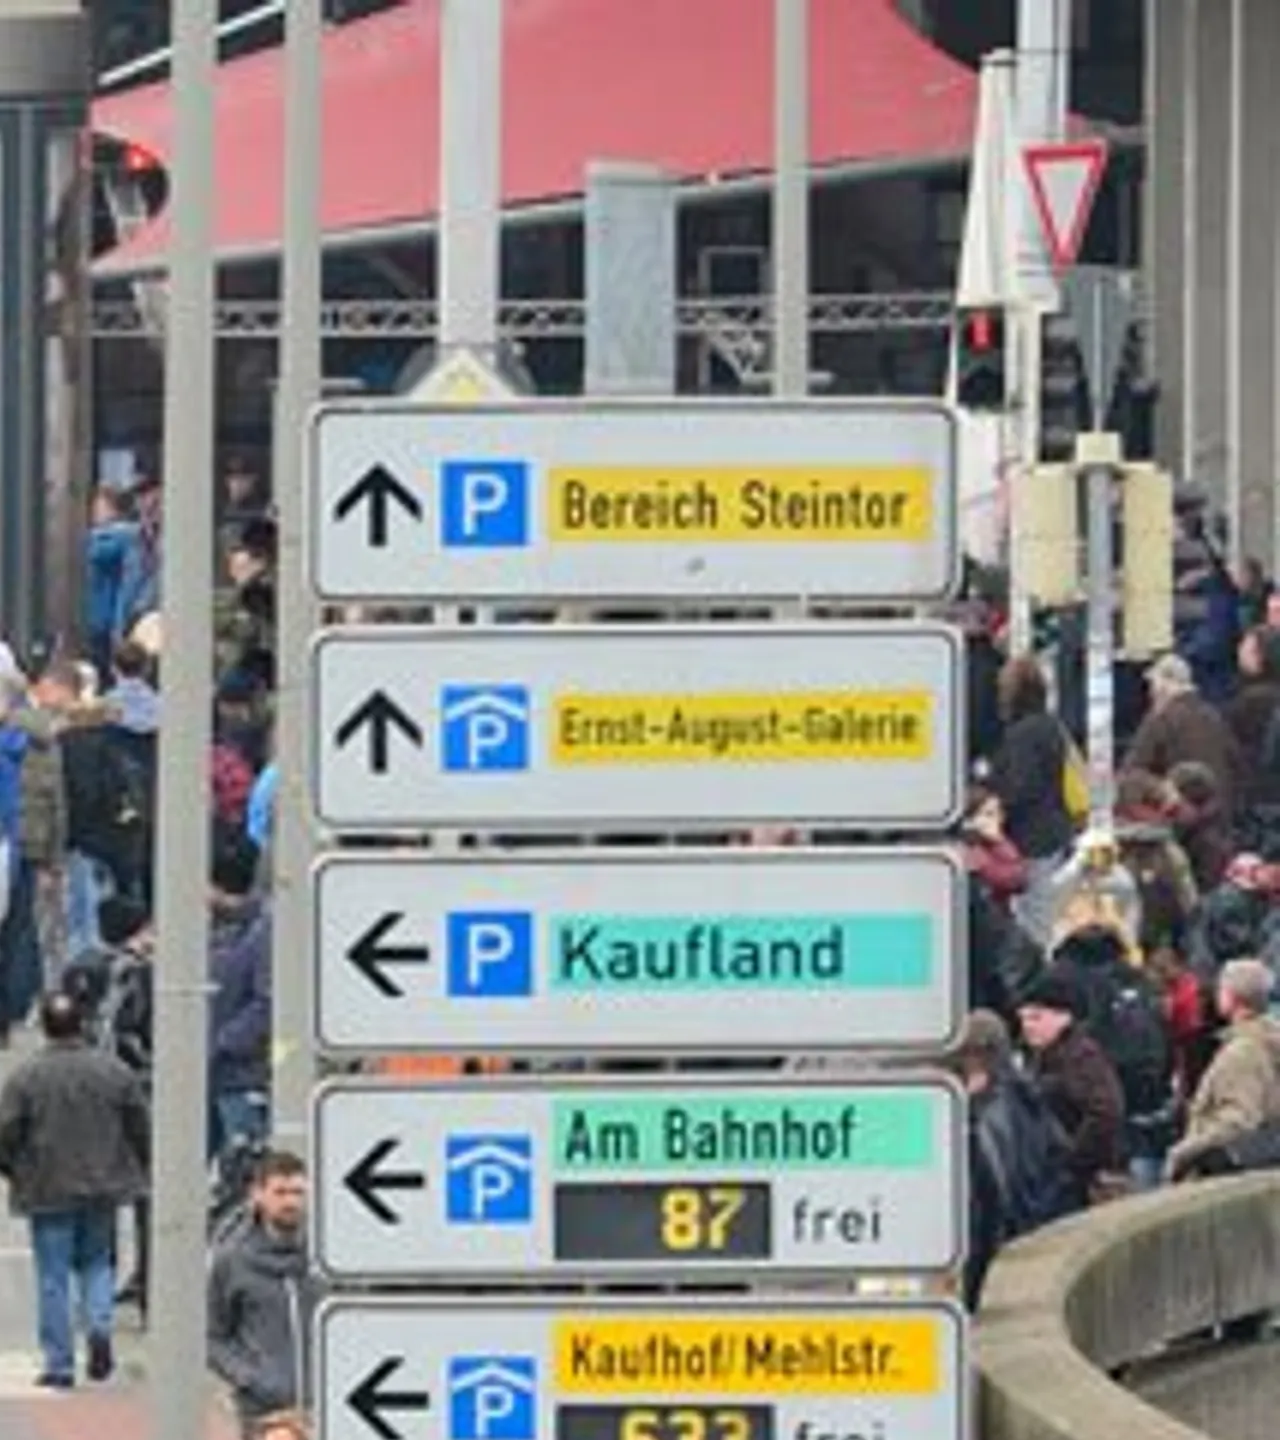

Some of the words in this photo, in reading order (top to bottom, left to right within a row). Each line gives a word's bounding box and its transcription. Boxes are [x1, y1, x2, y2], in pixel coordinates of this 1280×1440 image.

[461, 472, 509, 537] P
[562, 479, 719, 530] Bereich
[739, 479, 909, 530] Steintor
[468, 711, 510, 767] P
[559, 706, 918, 756] Ernst-August-Galerie
[468, 925, 513, 986] P
[559, 923, 845, 980] Kaufland
[470, 1168, 513, 1218] P
[563, 1111, 638, 1161] Am
[662, 1107, 855, 1161] Bahnhof
[659, 1189, 747, 1252] 87
[792, 1199, 882, 1244] frei
[475, 1387, 516, 1437] P
